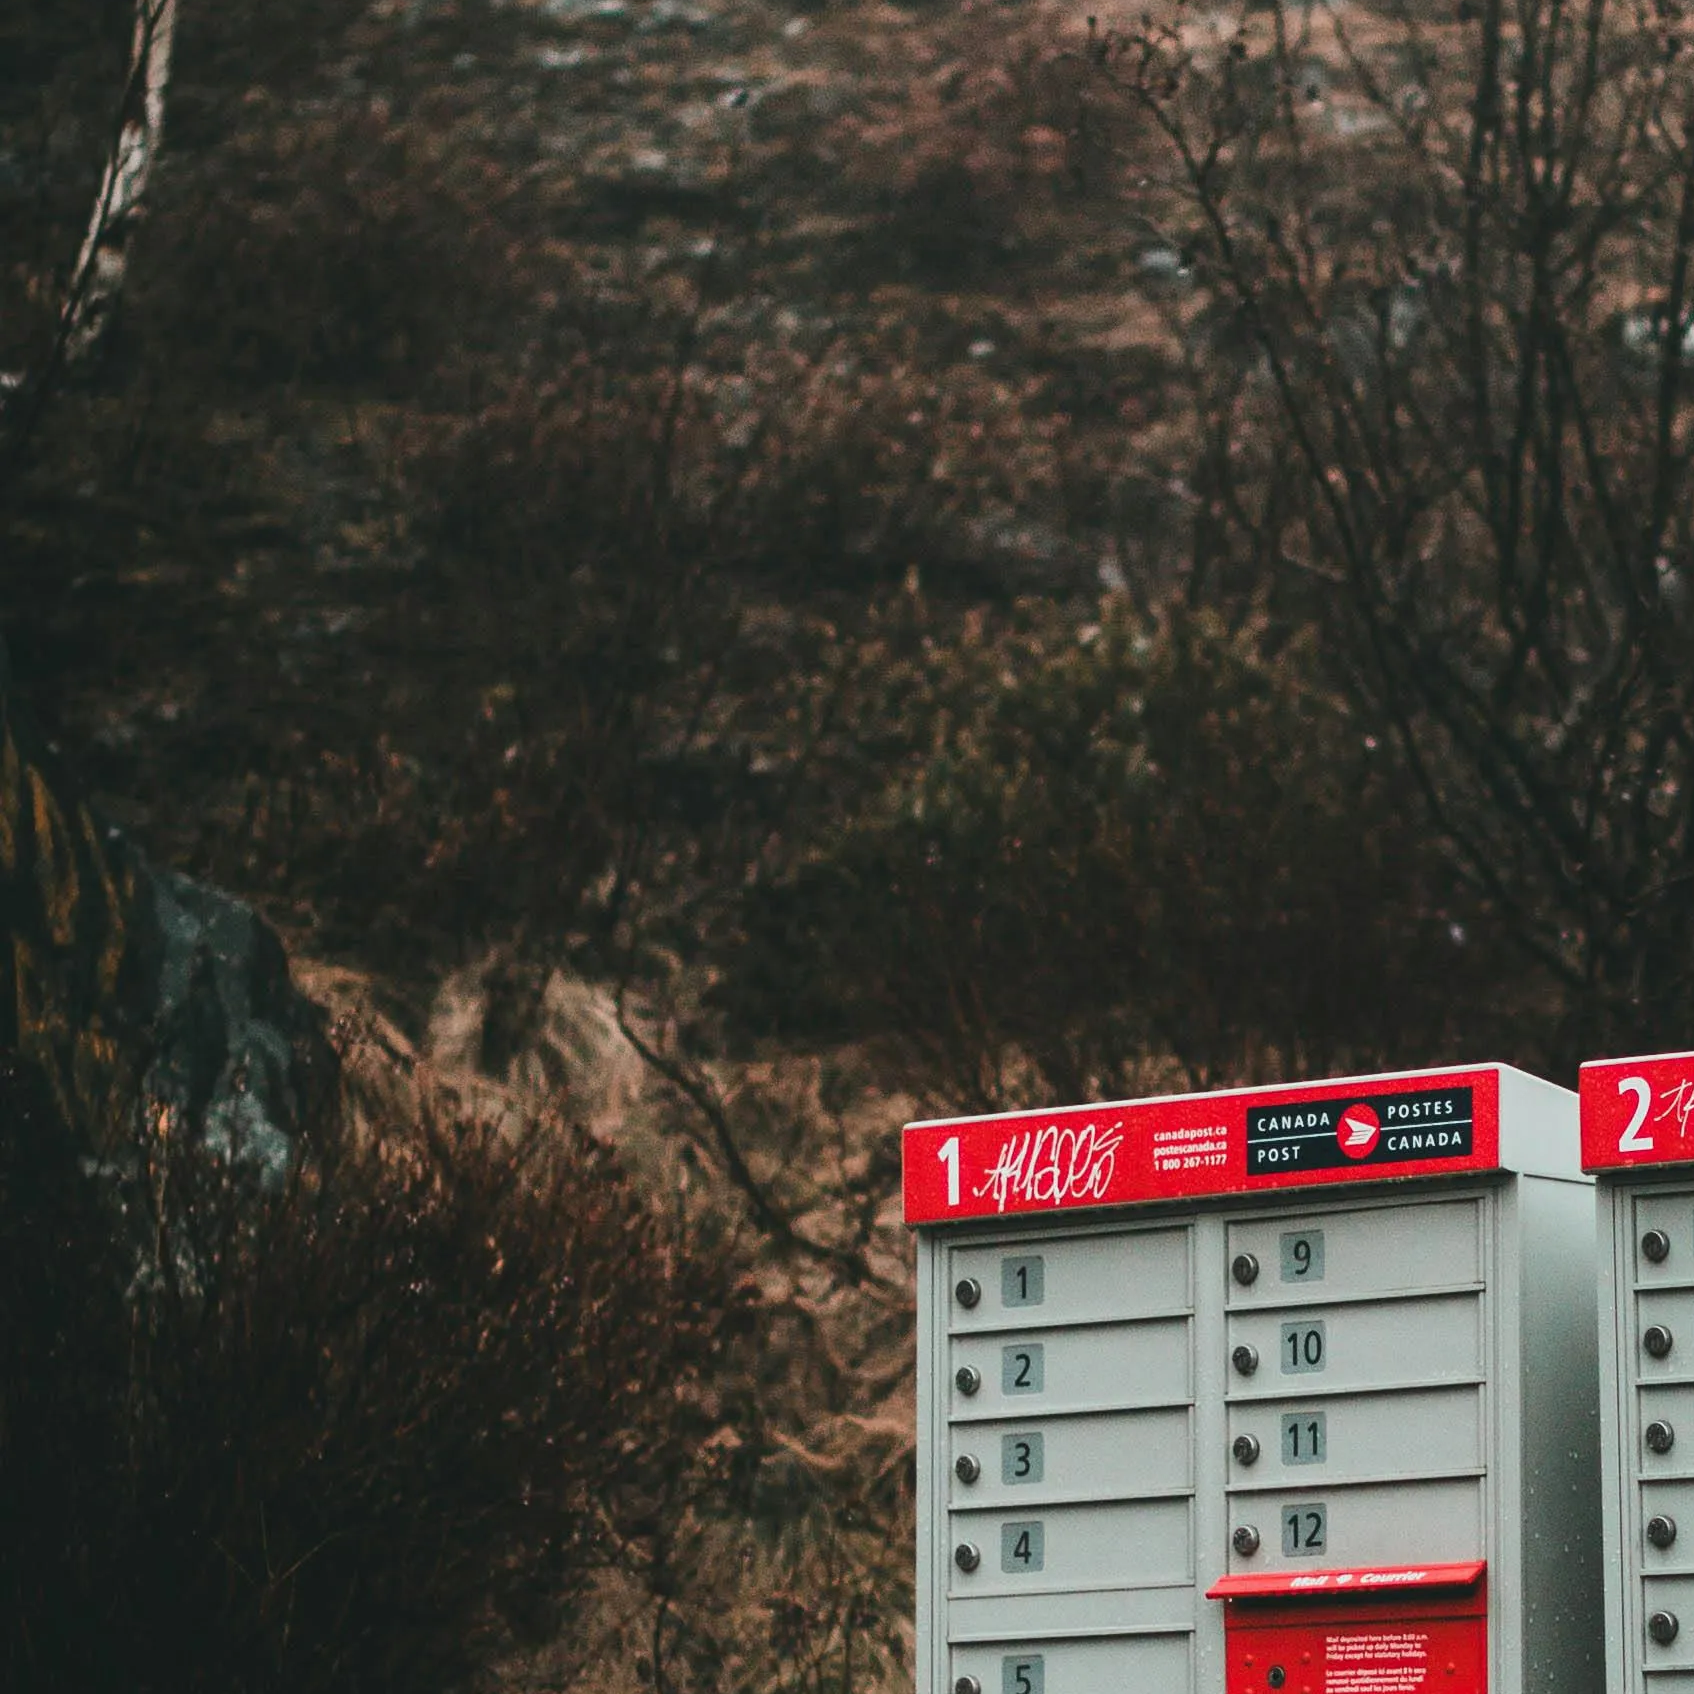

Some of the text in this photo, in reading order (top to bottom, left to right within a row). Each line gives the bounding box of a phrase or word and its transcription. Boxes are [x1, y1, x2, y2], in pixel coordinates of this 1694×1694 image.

[1257, 1112, 1330, 1132] CANADA
[1387, 1100, 1453, 1120] POSTES
[1617, 1076, 1656, 1154] 2
[1153, 1126, 1227, 1142] canadapost.ca
[1153, 1140, 1227, 1159] postescanada.ca
[1386, 1130, 1463, 1152] CANADA
[937, 1136, 960, 1206] 1
[1154, 1153, 1227, 1171] 1 800 267-1177
[1257, 1145, 1301, 1163] POST
[1293, 1239, 1312, 1276] 9
[1016, 1265, 1027, 1300] 1
[1287, 1329, 1322, 1367] 10
[1014, 1353, 1031, 1388] 2
[1288, 1421, 1318, 1458] 11
[1014, 1442, 1031, 1477] 3
[1013, 1530, 1033, 1565] 4
[1287, 1511, 1323, 1549] 12
[1290, 1571, 1427, 1587] Mail Courrier
